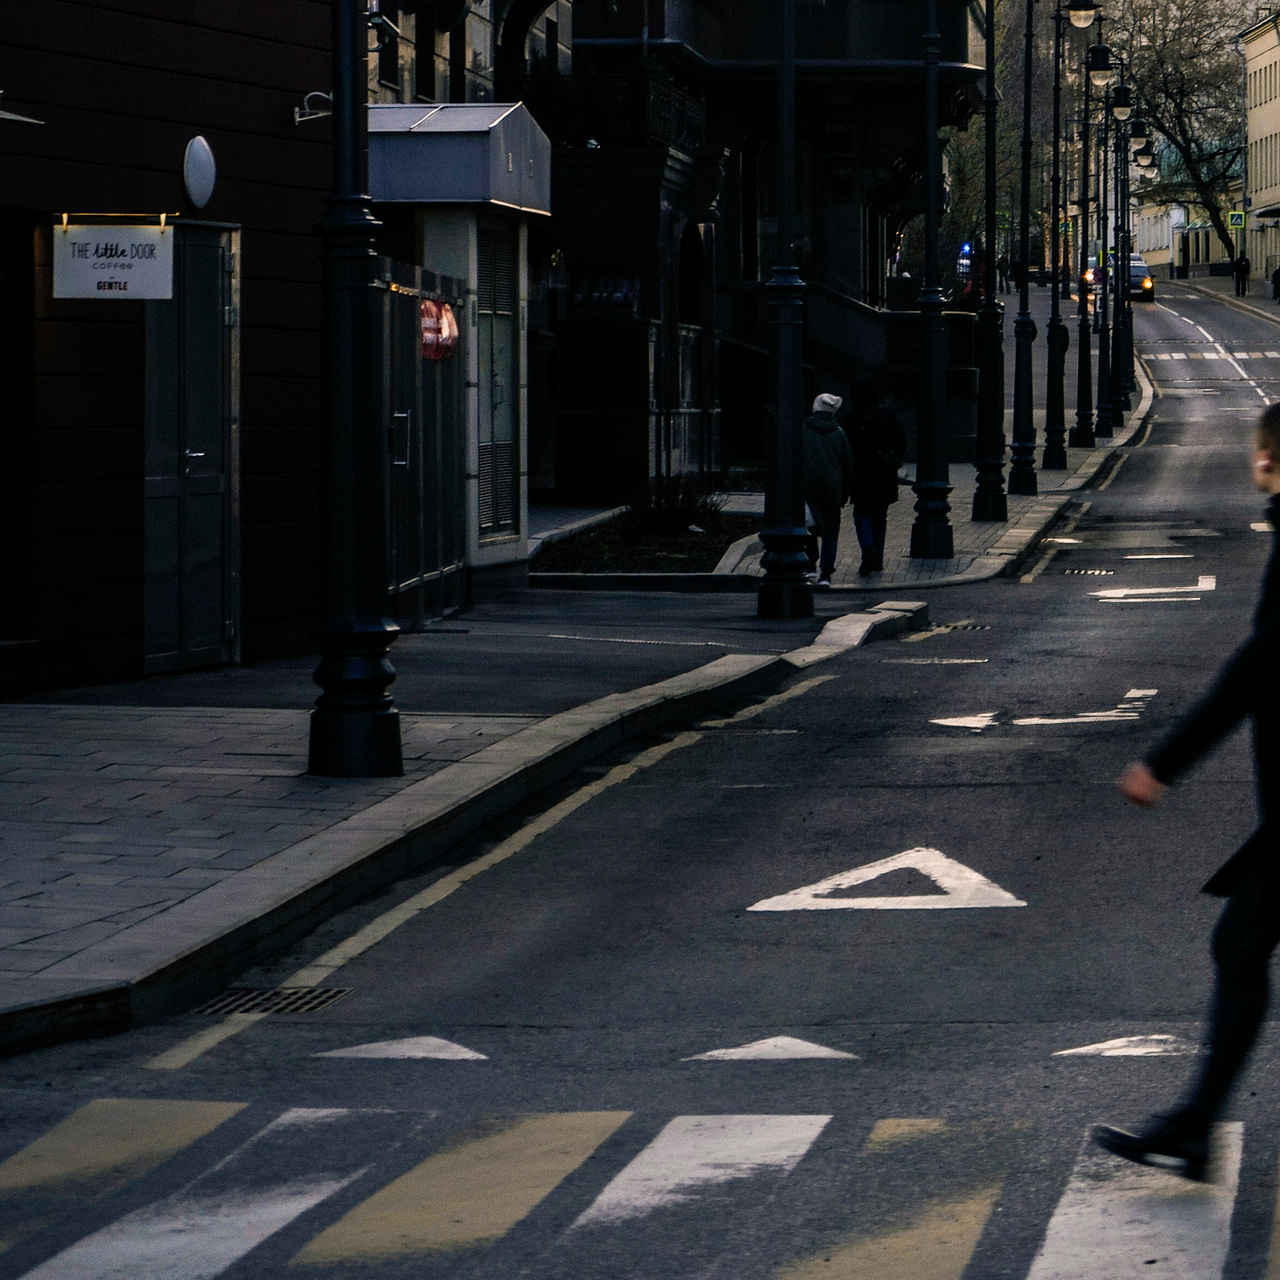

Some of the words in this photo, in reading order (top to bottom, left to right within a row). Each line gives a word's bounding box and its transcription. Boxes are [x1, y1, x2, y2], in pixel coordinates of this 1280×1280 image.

[70, 242, 89, 259] THE
[92, 243, 128, 259] little
[130, 243, 156, 259] DOOR
[96, 281, 128, 291] GENTLE
